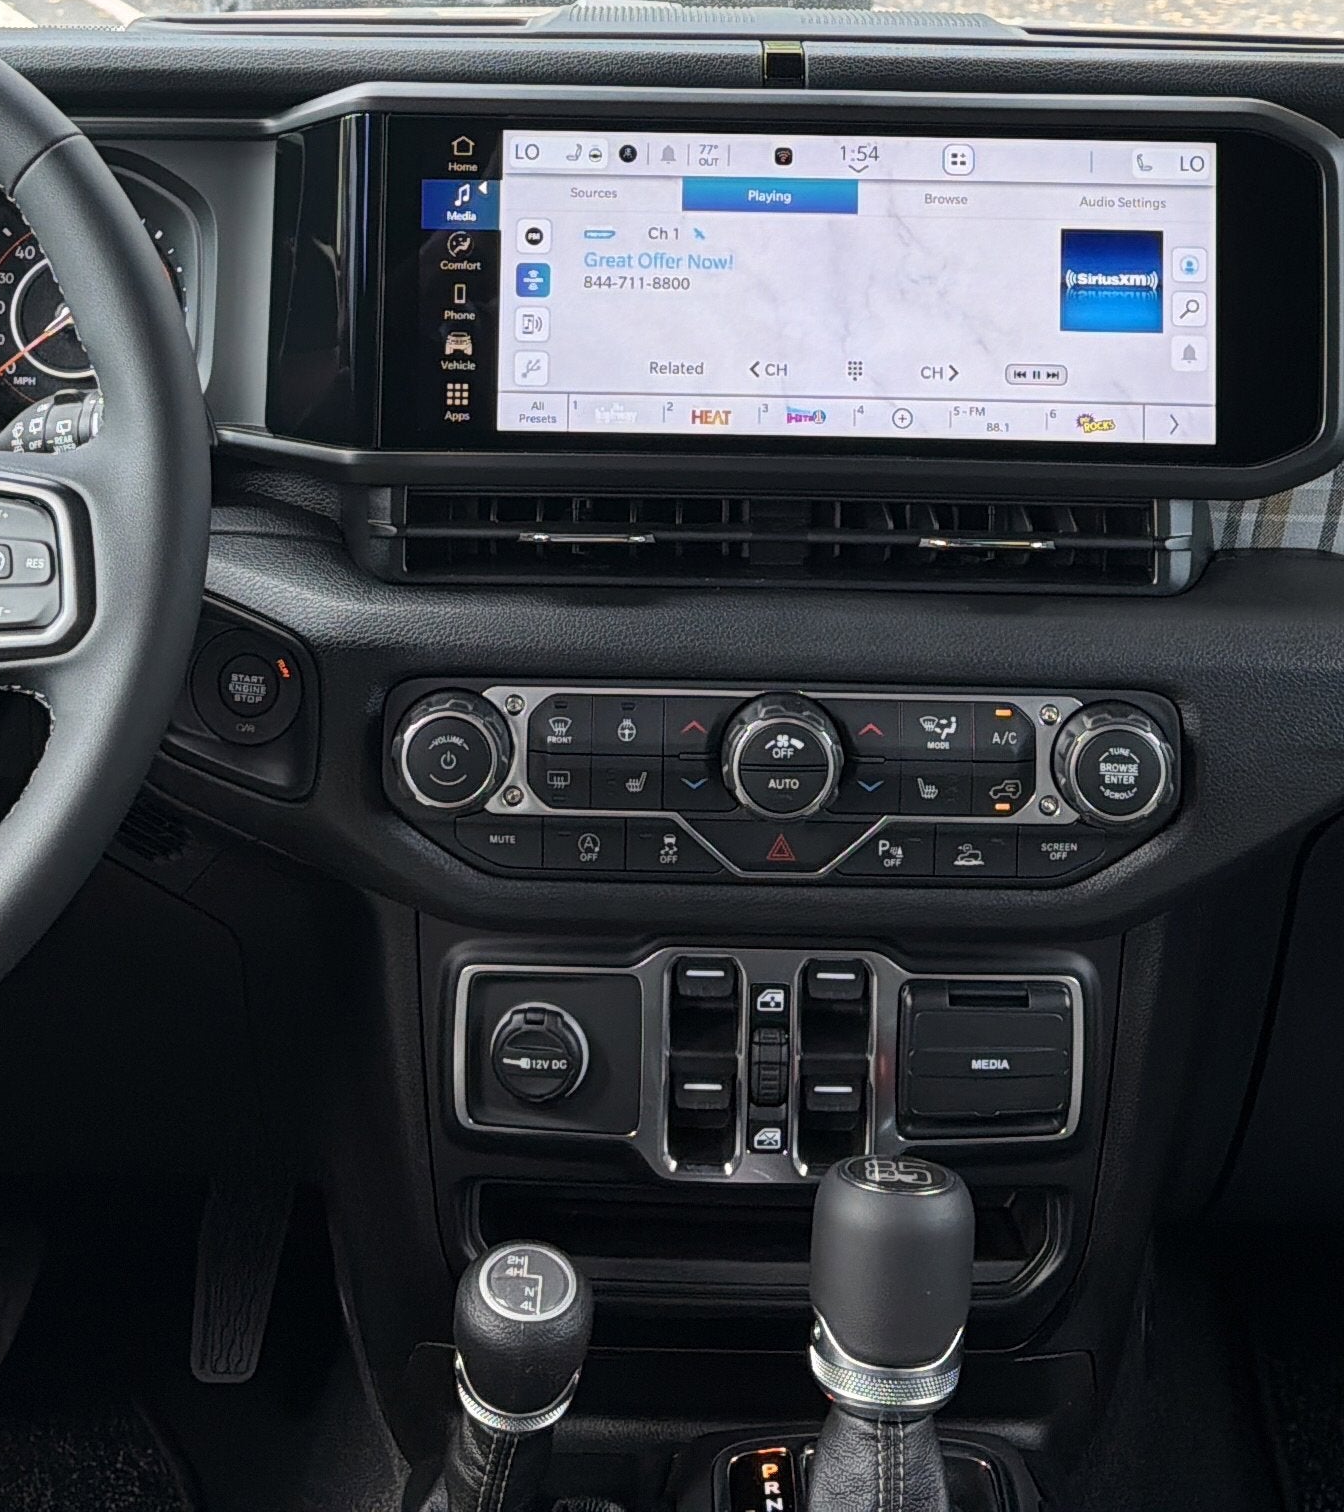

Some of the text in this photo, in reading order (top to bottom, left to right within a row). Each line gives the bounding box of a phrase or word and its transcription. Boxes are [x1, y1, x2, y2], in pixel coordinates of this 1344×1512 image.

[515, 143, 540, 160] LO
[699, 144, 718, 155] 77°
[840, 145, 880, 163] 1:54
[448, 161, 478, 172] Home
[699, 157, 719, 167] OUT
[1179, 156, 1205, 172] LO
[570, 188, 617, 199] Sources
[748, 190, 792, 205] Playing
[924, 193, 968, 205] Browse
[1080, 196, 1167, 212] Audio Settings
[447, 210, 476, 222] Media
[648, 227, 668, 241] Ch
[15, 246, 35, 260] 40
[440, 260, 481, 271] Comfort
[584, 252, 734, 269] Great Offer Now!
[583, 276, 690, 291] 844-711-8800
[444, 310, 475, 321] Phone
[441, 360, 476, 371] Vehicle
[649, 361, 704, 376] Related
[765, 363, 788, 377] CH
[920, 365, 944, 380] CH
[13, 377, 36, 386] MPH
[531, 401, 545, 412] All
[444, 411, 470, 422] Apps
[519, 413, 557, 425] Presets
[691, 409, 732, 425] HEAT
[986, 422, 1010, 433] 88.1
[25, 558, 44, 568] RES
[231, 673, 264, 683] START
[228, 683, 267, 695] ENGINE
[234, 694, 262, 703] STOP
[432, 736, 465, 746] VOLUME
[547, 736, 572, 744] FRONT
[992, 731, 1018, 746] A/C
[927, 742, 950, 750] MODE
[772, 747, 794, 759] OFF
[1099, 763, 1138, 775] BROWSE
[768, 779, 799, 790] AUTO
[1104, 774, 1135, 785] ENTER
[489, 835, 516, 844] MUTE
[1040, 843, 1077, 853] SCREEN
[579, 852, 598, 862] OFF
[660, 854, 678, 864] OFF
[1050, 852, 1067, 861] OFF
[884, 858, 902, 868] OFF
[532, 1060, 567, 1069] 12V DC
[972, 1059, 1010, 1070] MEDIA
[865, 1160, 932, 1185] 85
[507, 1255, 524, 1265] 2H
[505, 1267, 524, 1277] 4H
[520, 1301, 535, 1312] 4L
[762, 1463, 778, 1478] P
[764, 1481, 781, 1495] R
